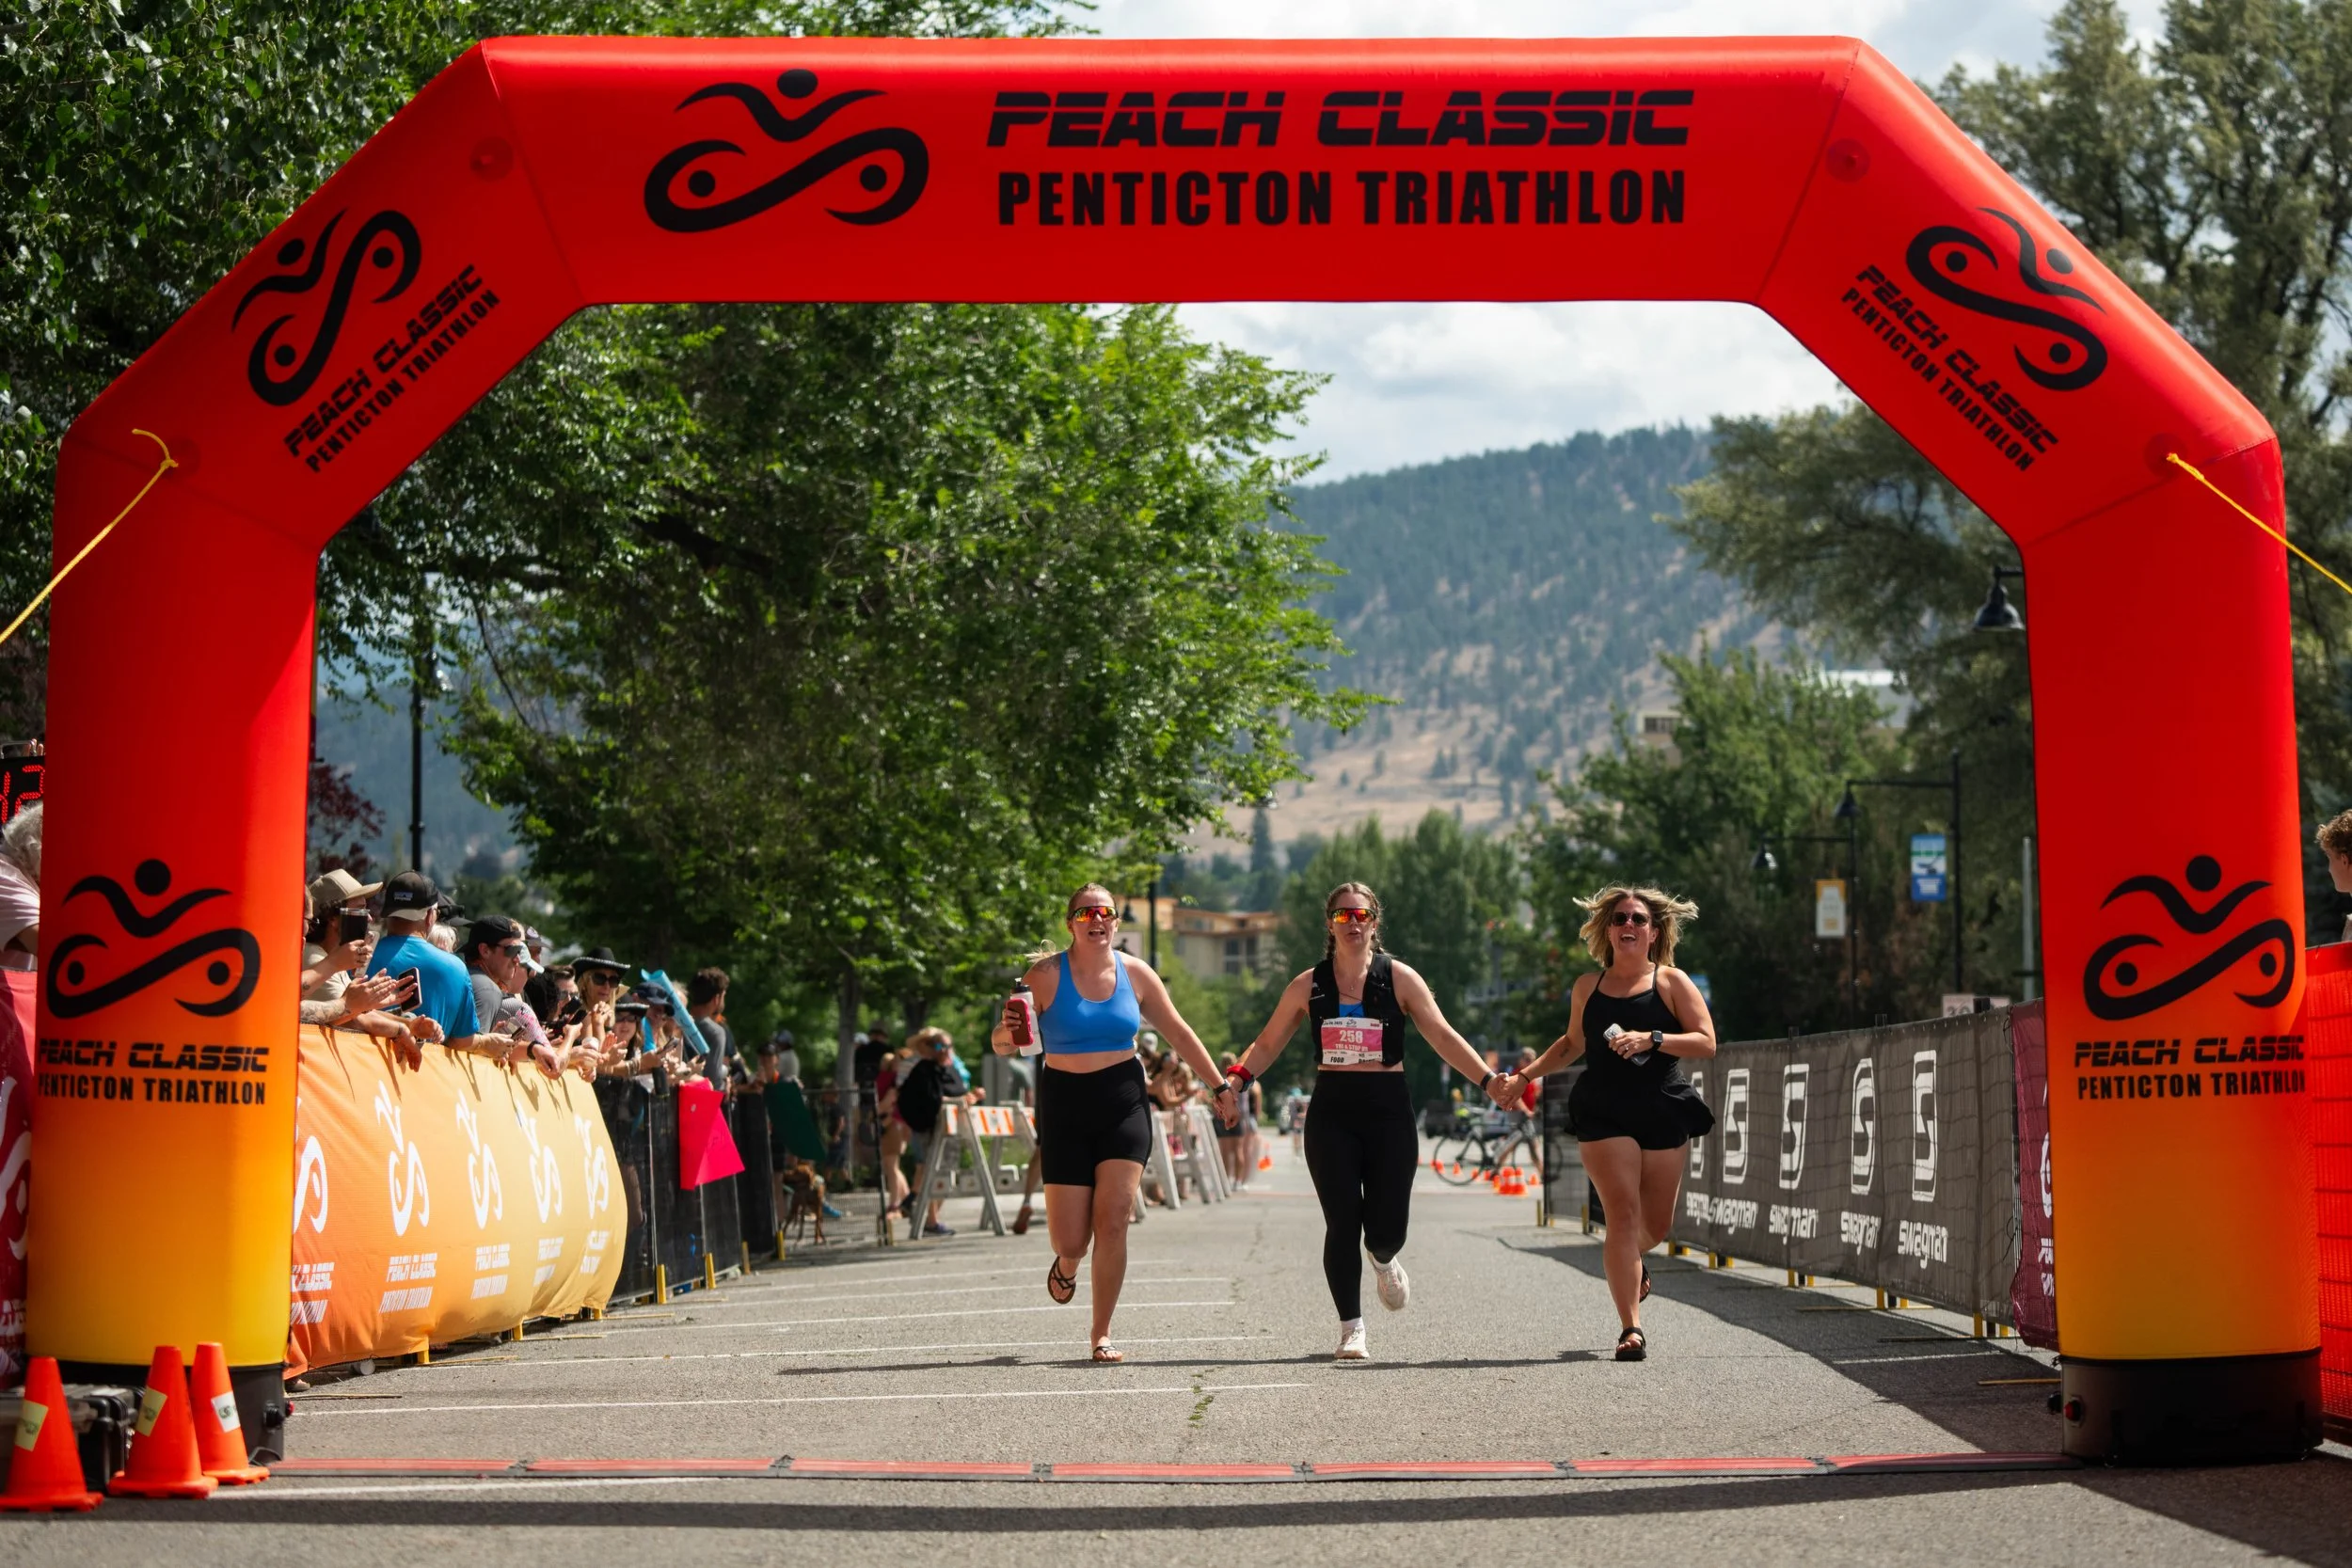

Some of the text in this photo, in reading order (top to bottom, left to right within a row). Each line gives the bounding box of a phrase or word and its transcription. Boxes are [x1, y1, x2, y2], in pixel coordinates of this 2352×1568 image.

[986, 89, 1694, 148] PEACH CLASSIC
[998, 169, 1685, 227] PENTICTON TRIATHLON
[283, 263, 483, 458] PEACH CLASSIC
[305, 289, 501, 473] PENTICTON TRIATHLON
[1840, 287, 2035, 472] PENTICTON TRIATHLON
[1855, 264, 2058, 453] PEACH CLASSIC
[39, 1037, 270, 1072] PEACH CLASSIC
[1340, 1029, 1363, 1044] 258
[2074, 1035, 2304, 1068] PEACH CLASSIC
[38, 1073, 265, 1105] PENTICTON TRIATHLON
[2077, 1069, 2306, 1101] PENTICTON TRIATHLON
